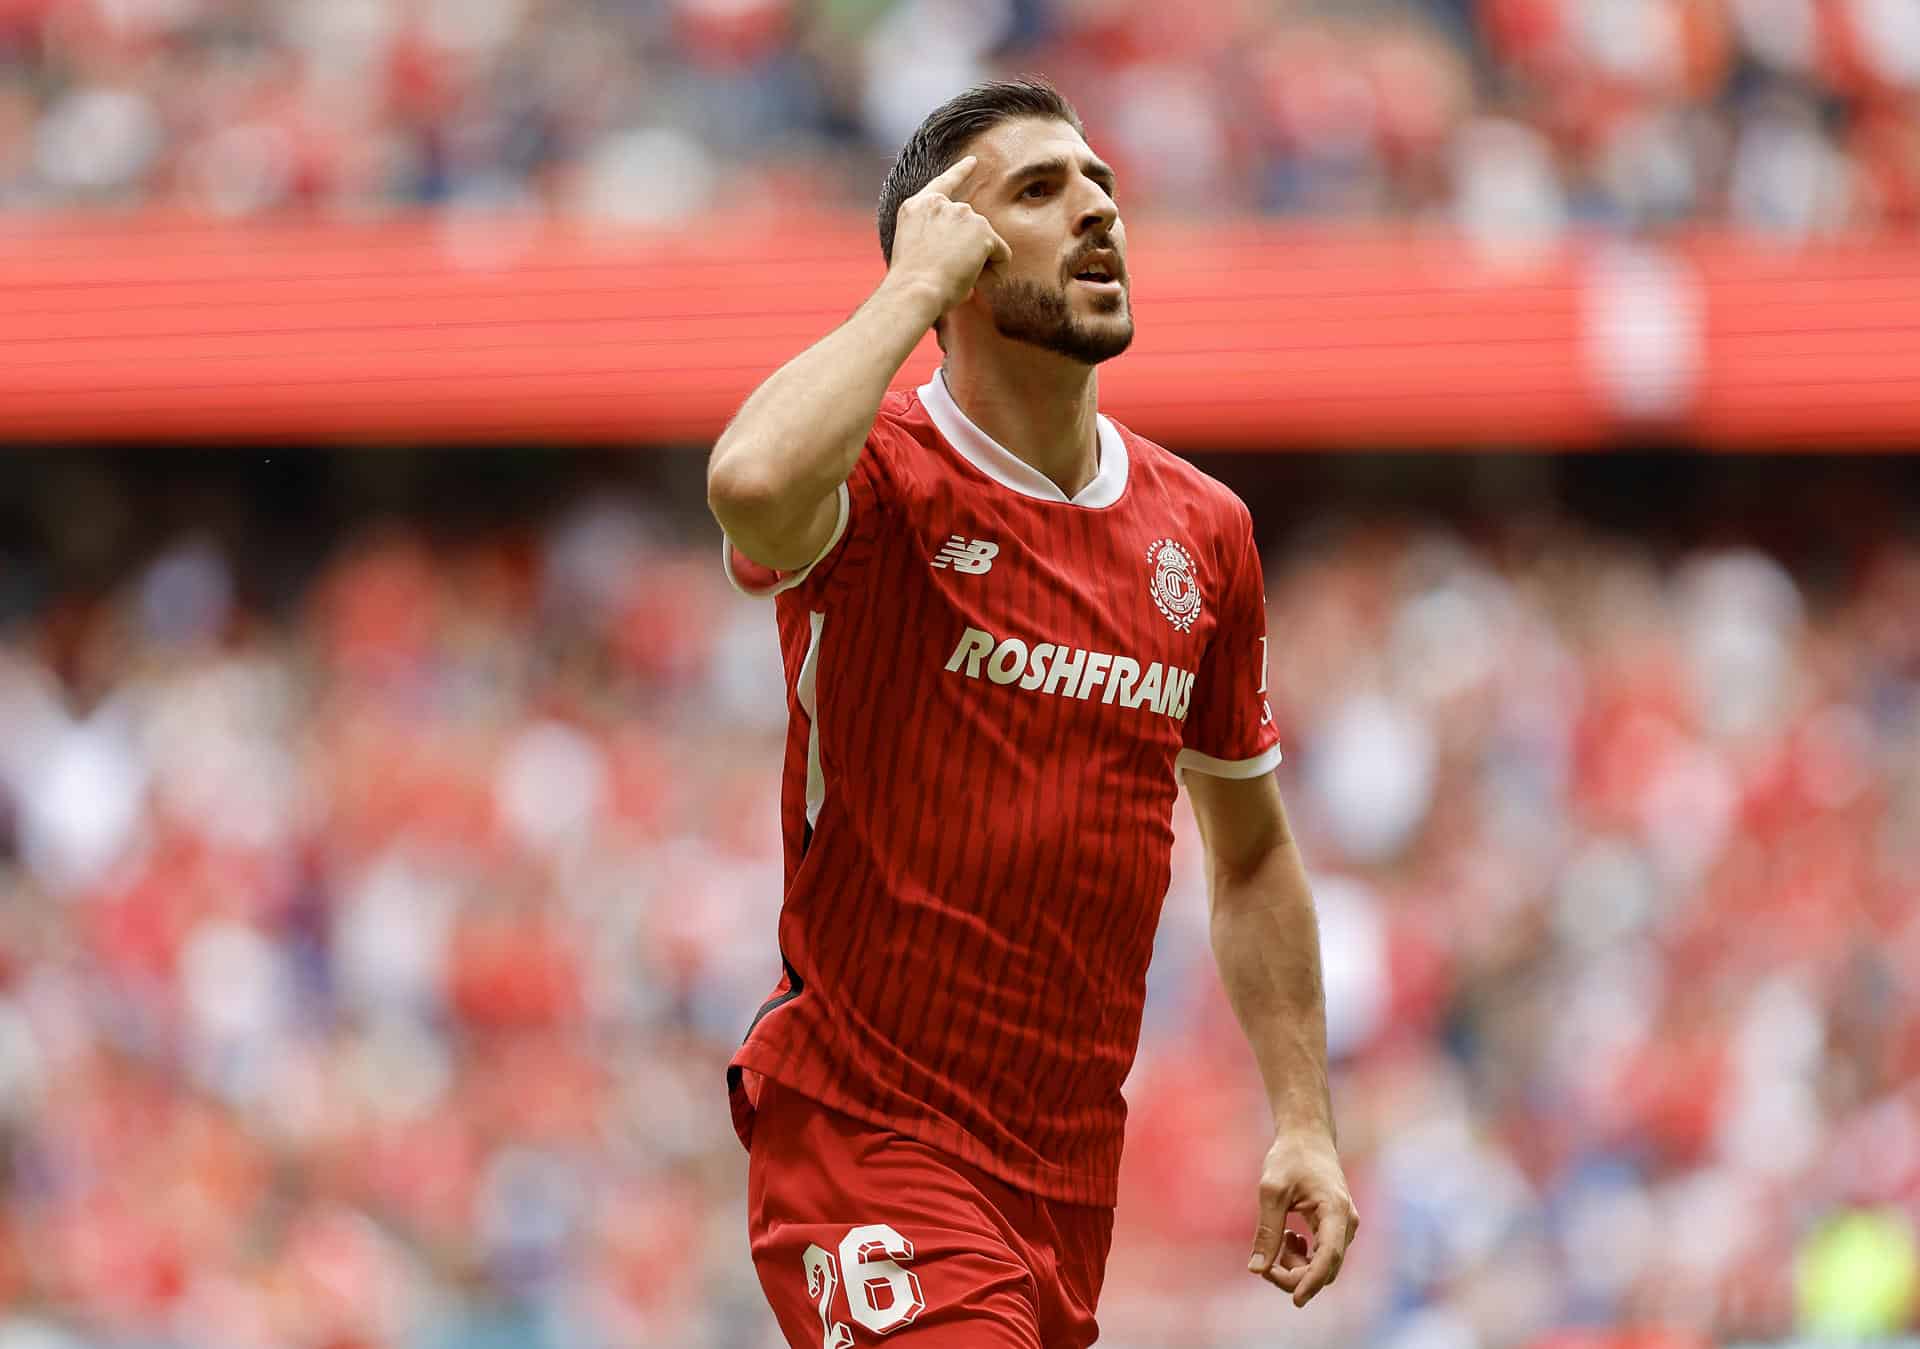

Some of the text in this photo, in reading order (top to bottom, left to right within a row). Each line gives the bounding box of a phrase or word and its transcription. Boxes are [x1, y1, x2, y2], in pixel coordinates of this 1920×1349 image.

[931, 535, 999, 575] NB
[944, 627, 1195, 719] ROSHFRANS
[802, 1224, 925, 1349] 26
